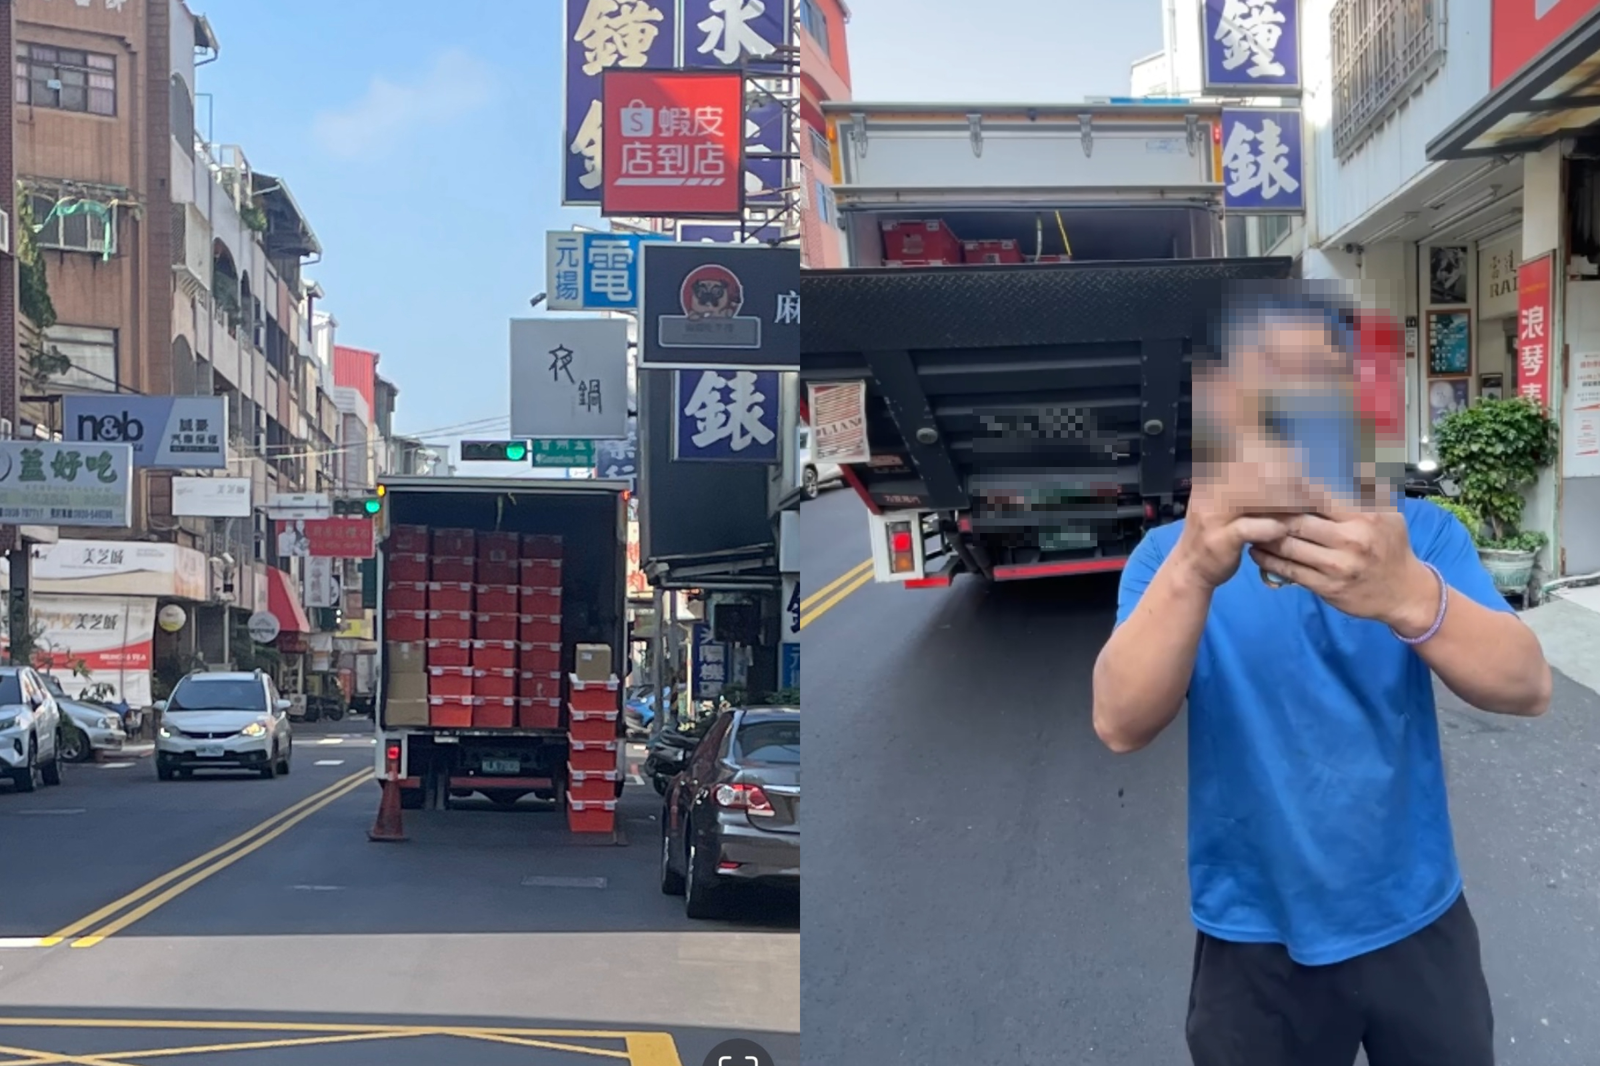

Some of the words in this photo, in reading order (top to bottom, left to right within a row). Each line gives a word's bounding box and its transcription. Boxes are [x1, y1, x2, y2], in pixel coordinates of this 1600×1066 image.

[1214, 0, 1286, 78] 鐘
[658, 106, 725, 137] 蝦皮
[621, 142, 725, 176] 店到店
[1222, 118, 1300, 200] 錶
[588, 239, 633, 301] 電
[1490, 276, 1519, 298] RA
[548, 343, 603, 414] 夜鍋
[77, 411, 143, 441] n&b
[685, 371, 775, 452] 錶
[83, 548, 124, 564] 美芝城
